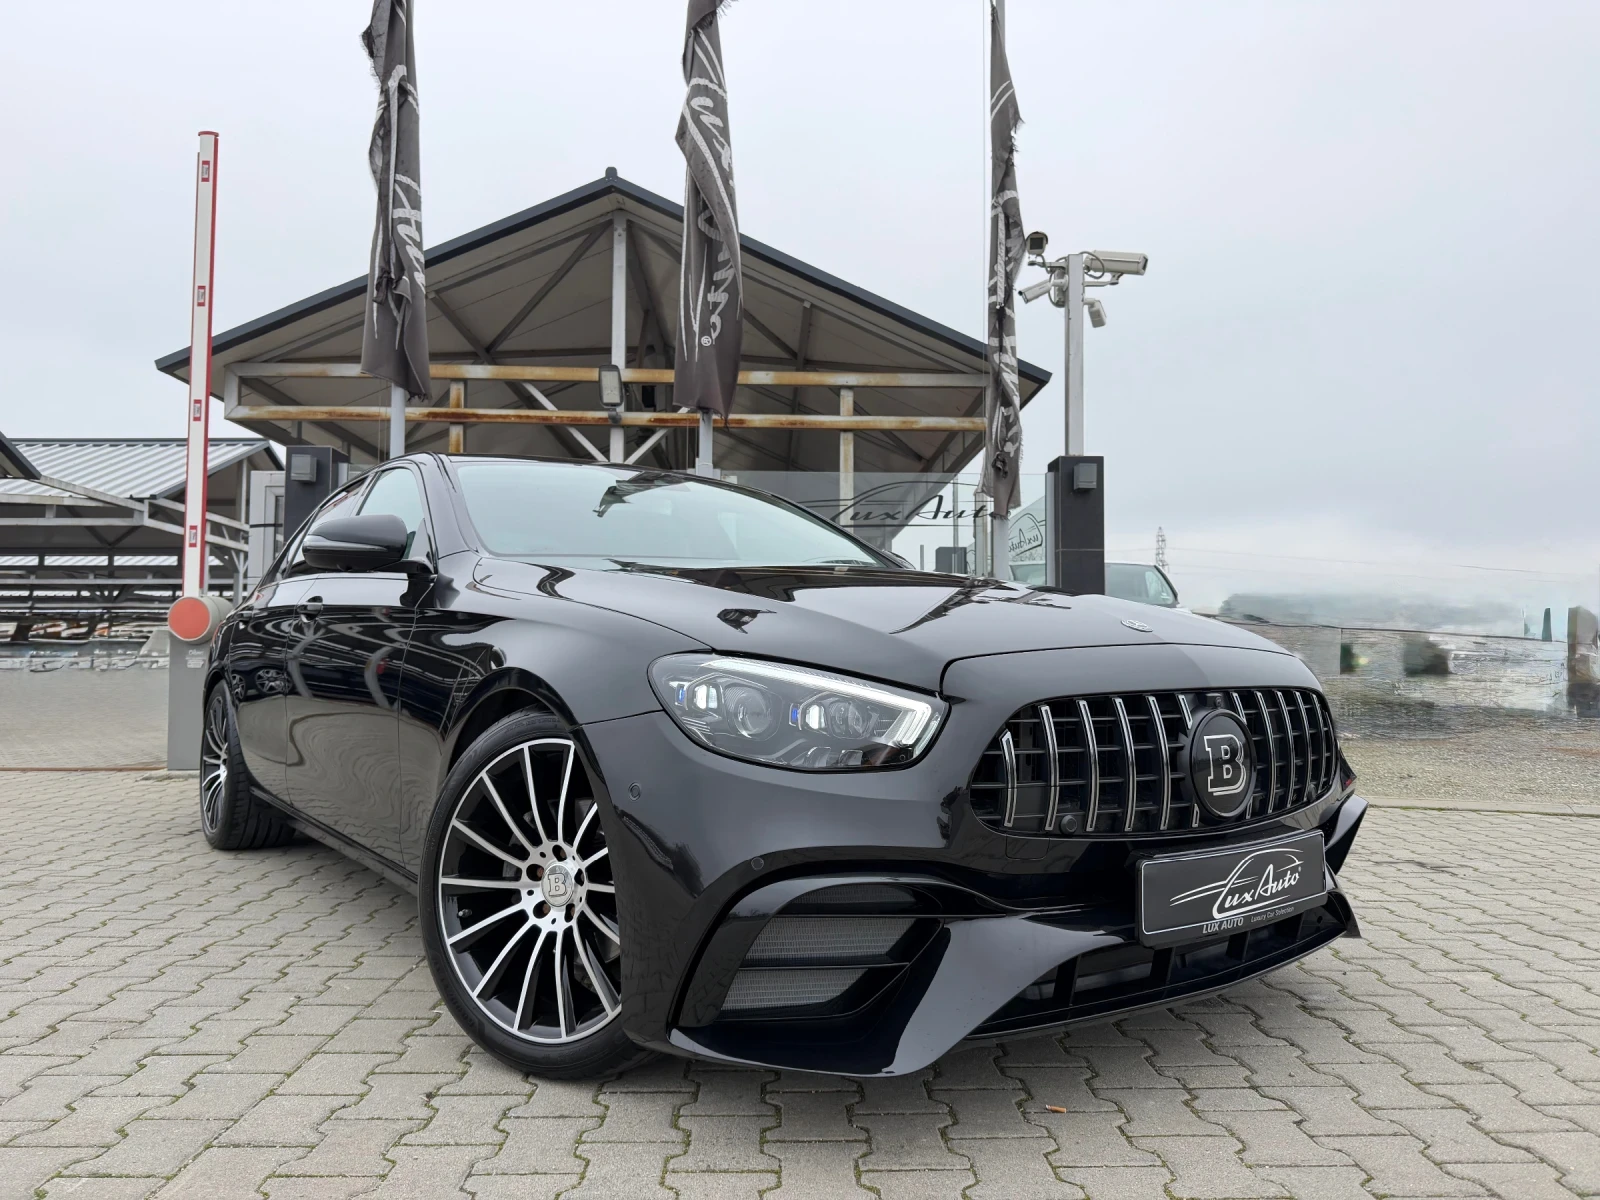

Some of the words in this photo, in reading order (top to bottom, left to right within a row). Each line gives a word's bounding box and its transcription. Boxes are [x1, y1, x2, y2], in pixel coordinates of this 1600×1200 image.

[1203, 733, 1247, 796] B
[548, 873, 567, 897] B
[1250, 913, 1267, 923] Luxury
[1267, 911, 1275, 919] Car
[1275, 906, 1295, 917] Selection
[1202, 921, 1221, 934] LUX
[1221, 917, 1244, 931] AUTO
